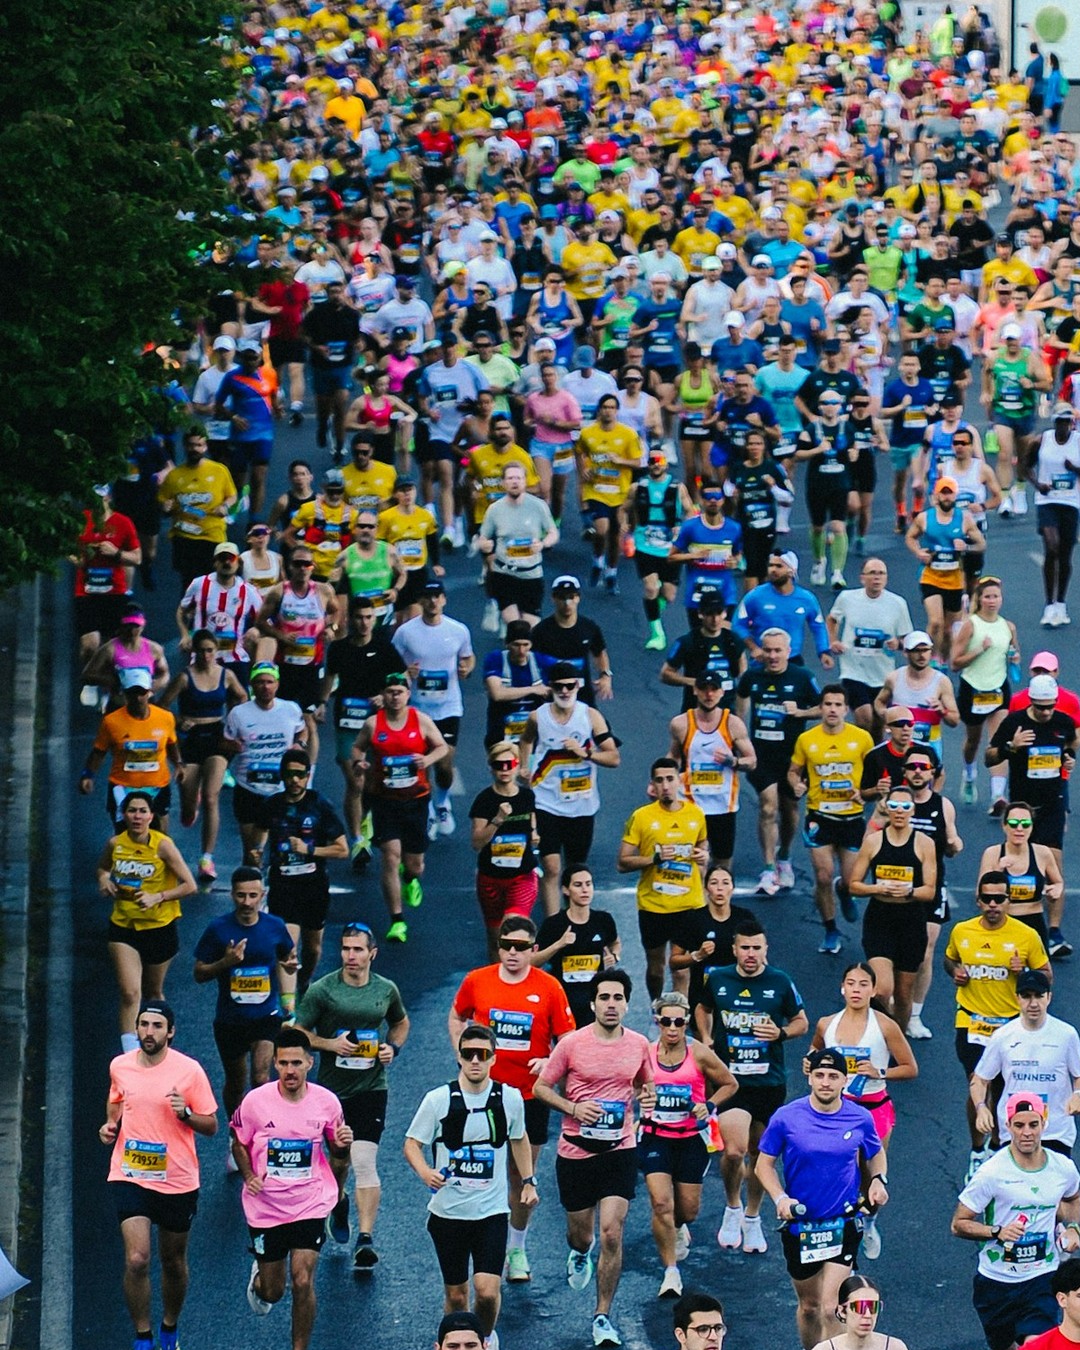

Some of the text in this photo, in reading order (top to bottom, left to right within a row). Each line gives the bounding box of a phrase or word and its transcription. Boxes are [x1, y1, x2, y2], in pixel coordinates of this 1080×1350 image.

[965, 963, 1009, 981] MADRID
[1012, 1071, 1057, 1083] RUNNERS
[466, 1150, 491, 1159] ZRICH
[459, 1161, 484, 1174] 4650
